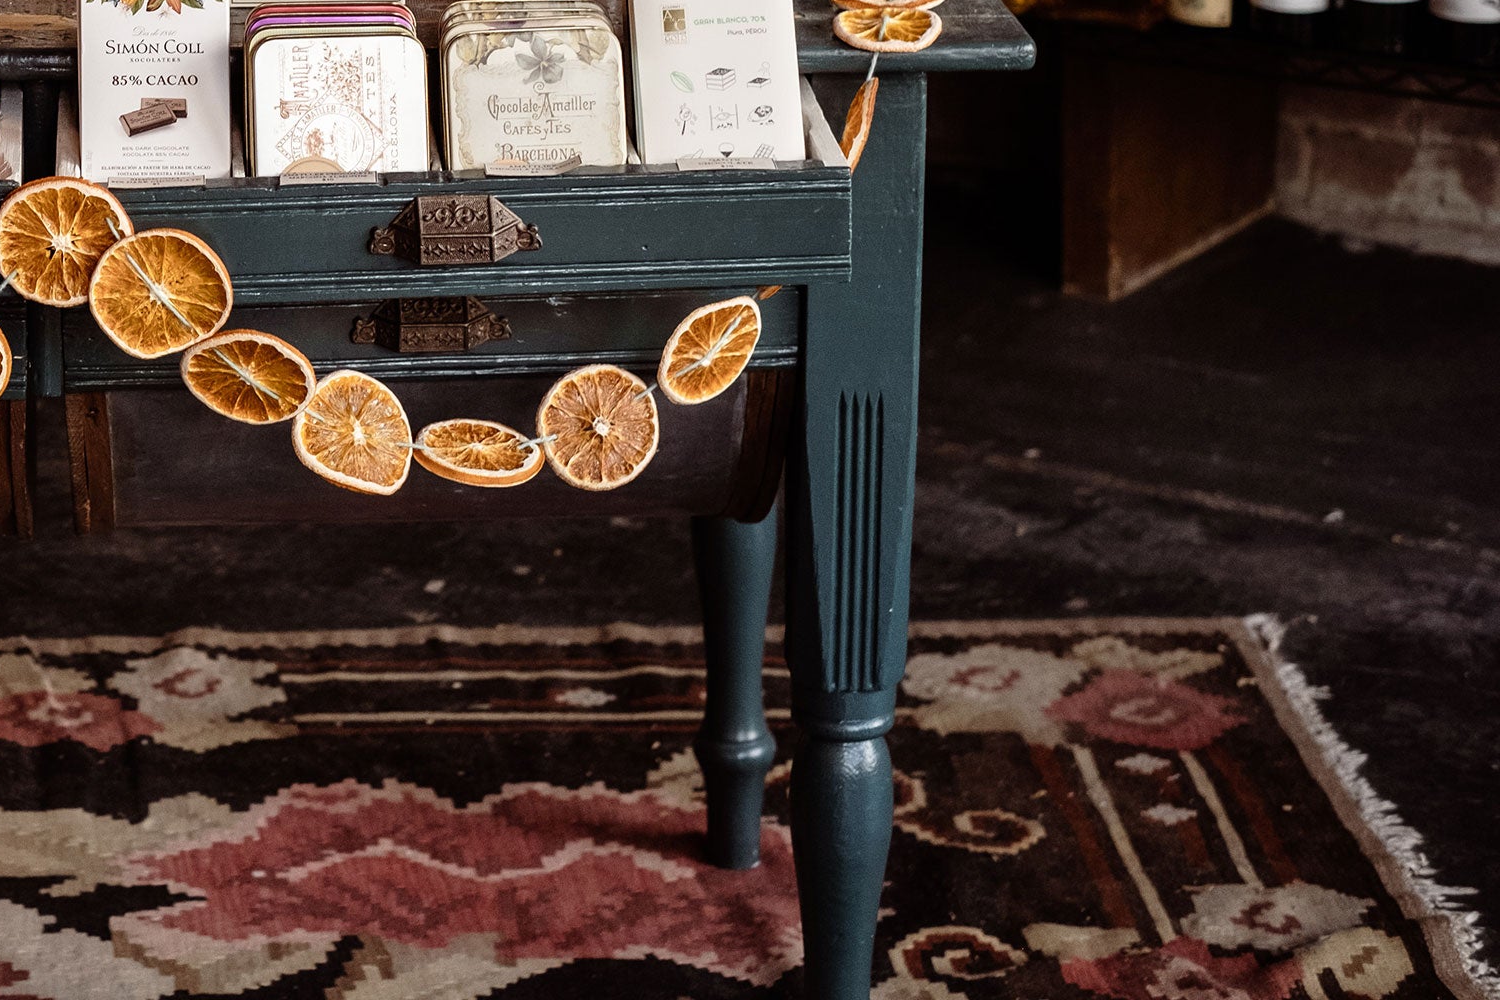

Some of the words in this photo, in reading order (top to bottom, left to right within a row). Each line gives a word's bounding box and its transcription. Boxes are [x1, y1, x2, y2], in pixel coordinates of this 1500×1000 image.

[694, 18, 715, 26] GRAN
[717, 16, 749, 25] BLANCO,
[112, 75, 143, 86] 85%
[146, 74, 199, 86] CACAO
[389, 93, 399, 169] RCELONA
